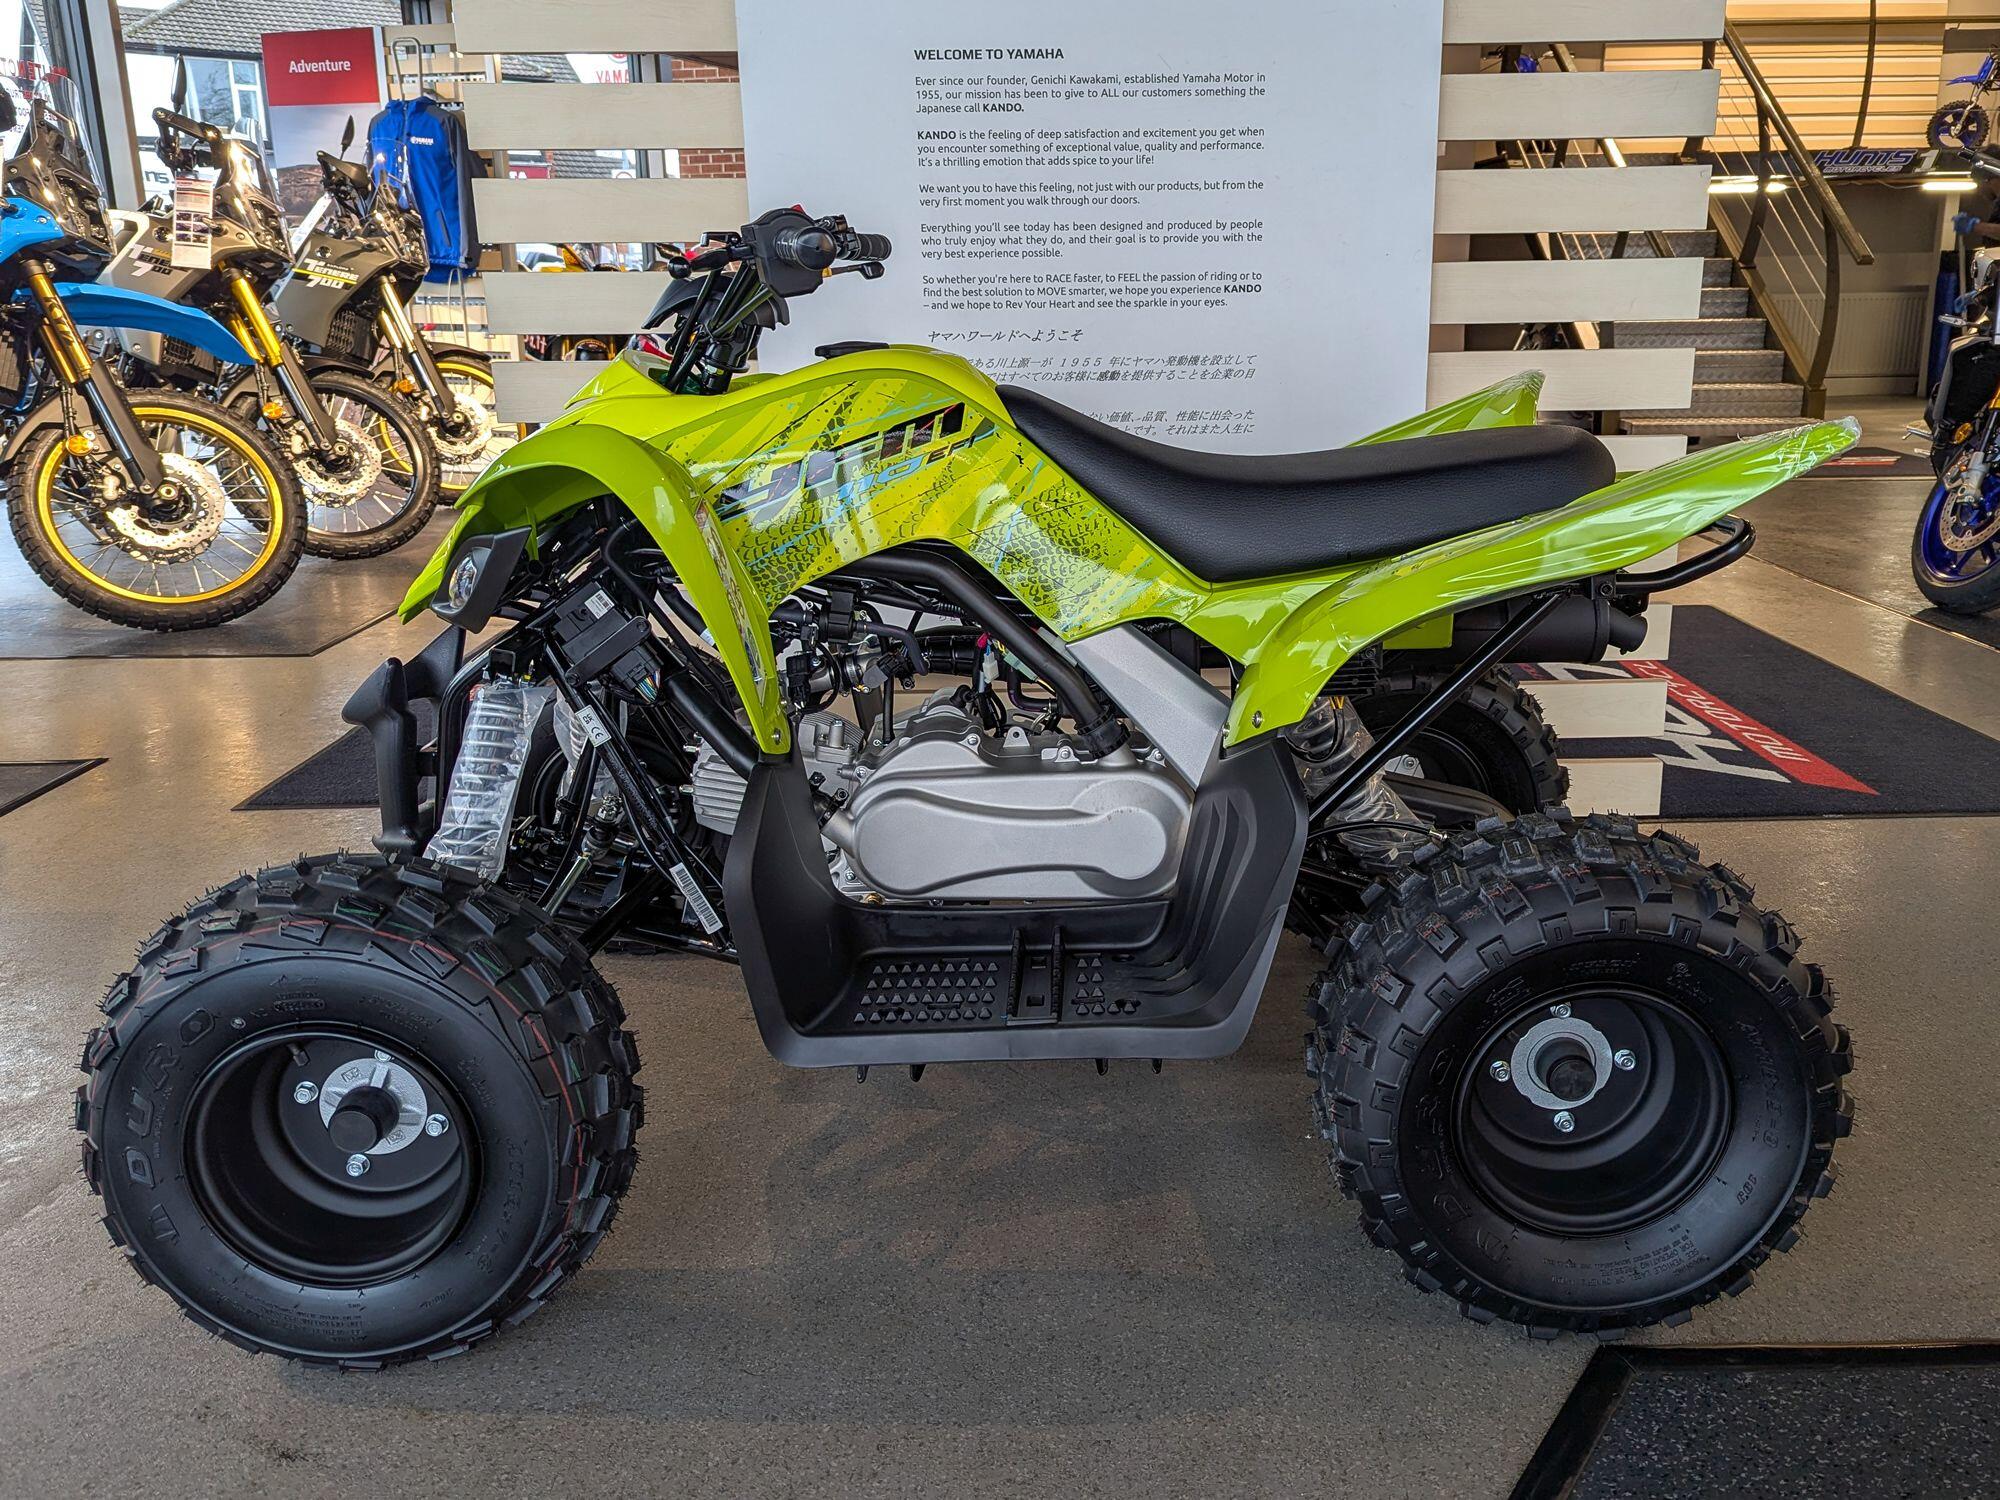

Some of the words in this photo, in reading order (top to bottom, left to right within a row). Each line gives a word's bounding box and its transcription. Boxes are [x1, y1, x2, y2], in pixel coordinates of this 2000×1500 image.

[913, 49, 983, 60] WELCOME
[985, 48, 1004, 60] TO
[1006, 48, 1064, 60] YAMAHA
[289, 59, 351, 73] Adventure
[915, 76, 936, 86] Ever
[939, 76, 964, 86] since
[966, 77, 984, 86] our
[986, 75, 1028, 86] founder,
[1030, 74, 1067, 85] Genichi
[1069, 74, 1121, 86] Kawakami,
[1124, 73, 1180, 84] established
[1182, 72, 1221, 83] Yamaha
[1223, 73, 1254, 83] Motor
[1257, 72, 1266, 82] in
[916, 90, 943, 100] 1955,
[945, 91, 962, 99] our
[965, 89, 1002, 99] mission
[1004, 88, 1021, 99] has
[1023, 88, 1048, 99] been
[1051, 89, 1062, 98] to
[1064, 88, 1085, 99] give
[1087, 89, 1098, 98] to
[1100, 88, 1120, 98] ALL
[1122, 89, 1139, 98] our
[1141, 88, 1192, 98] customers
[1194, 86, 1246, 98] something
[1249, 85, 1266, 96] the
[916, 104, 962, 115] Japanese
[963, 102, 981, 113] call
[982, 102, 1025, 113] KANDO.
[917, 130, 957, 140] KANDO
[959, 130, 967, 140] is
[969, 129, 986, 140] the
[988, 129, 1022, 141] feeling
[1024, 129, 1035, 139] of
[1037, 129, 1062, 140] deep
[1064, 128, 1120, 139] satisfaction
[1122, 128, 1140, 138] and
[1142, 128, 1197, 138] excitement
[1199, 129, 1217, 139] you
[1219, 127, 1236, 139] get
[1238, 126, 1265, 136] when
[917, 146, 936, 155] you
[937, 144, 987, 154] encounter
[989, 142, 1041, 154] something
[1042, 142, 1054, 152] of
[1055, 141, 1112, 154] exceptional
[1113, 141, 1142, 153] value,
[1144, 141, 1178, 153] quality
[1179, 140, 1198, 151] and
[1200, 140, 1265, 152] performance.
[934, 159, 941, 167] a
[942, 156, 981, 168] thrilling
[982, 156, 1023, 166] emotion
[1025, 156, 1046, 166] that
[1047, 155, 1071, 166] adds
[1072, 155, 1097, 167] spice
[1099, 156, 1110, 165] to
[1111, 157, 1134, 167] your
[1136, 154, 1154, 165] life!
[1814, 149, 1918, 166] HUNTS
[1914, 149, 1940, 173] 1
[1822, 165, 1903, 174] MOTORCYCLES
[919, 199, 941, 208] very
[942, 196, 963, 206] first
[964, 197, 1005, 206] moment
[1006, 198, 1025, 208] you
[1026, 195, 1049, 206] walk
[1051, 195, 1090, 207] through
[1091, 197, 1109, 205] our
[1110, 195, 1140, 205] doors.
[920, 222, 972, 234] Everything
[1003, 224, 1020, 232] see
[1023, 221, 1051, 233] today
[1053, 221, 1070, 232] has
[1072, 221, 1097, 231] been
[1099, 220, 1143, 233] designed
[1146, 220, 1164, 230] and
[1167, 219, 1213, 232] produced
[1215, 219, 1227, 231] by
[1230, 218, 1263, 231] people
[920, 236, 942, 246] who
[944, 235, 969, 247] truly
[970, 235, 996, 247] enjoy
[998, 235, 1023, 245] what
[1026, 234, 1048, 246] they
[1050, 235, 1066, 245] do,
[1068, 234, 1086, 244] and
[1089, 234, 1114, 244] their
[1115, 233, 1136, 246] goal
[1139, 234, 1147, 243] is
[1149, 234, 1160, 243] to
[1163, 233, 1199, 245] provide
[1201, 235, 1220, 244] you
[1222, 232, 1244, 242] with
[1246, 232, 1263, 242] the
[921, 251, 943, 260] very
[944, 248, 966, 259] best
[967, 248, 1020, 260] experience
[1021, 247, 1063, 259] possible.
[131, 261, 173, 277] 700
[306, 275, 345, 289] 700
[922, 275, 935, 285] So
[936, 274, 976, 284] whether
[1009, 274, 1031, 284] here
[1033, 274, 1044, 283] to
[1045, 273, 1072, 283] RACE
[1073, 273, 1104, 284] faster,
[1105, 273, 1116, 283] to
[1117, 273, 1141, 282] FEEL
[1142, 272, 1159, 282] the
[1160, 272, 1196, 283] passion
[1197, 271, 1209, 281] of
[1210, 271, 1238, 283] riding
[1239, 273, 1250, 281] or
[1252, 272, 1262, 281] to
[923, 287, 942, 297] find
[944, 287, 960, 297] the
[962, 287, 983, 297] best
[984, 287, 1023, 297] solution
[1024, 287, 1035, 296] to
[1037, 286, 1067, 296] MOVE
[1068, 287, 1107, 297] smarter,
[1108, 287, 1123, 295] we
[1125, 285, 1149, 296] hope
[1150, 287, 1168, 297] you
[1169, 285, 1222, 296] experience
[1223, 284, 1262, 293] KANDO
[928, 329, 1084, 343] ヤマハワールドへようこそ
[590, 726, 604, 740] CE
[124, 1007, 214, 1188] DURO
